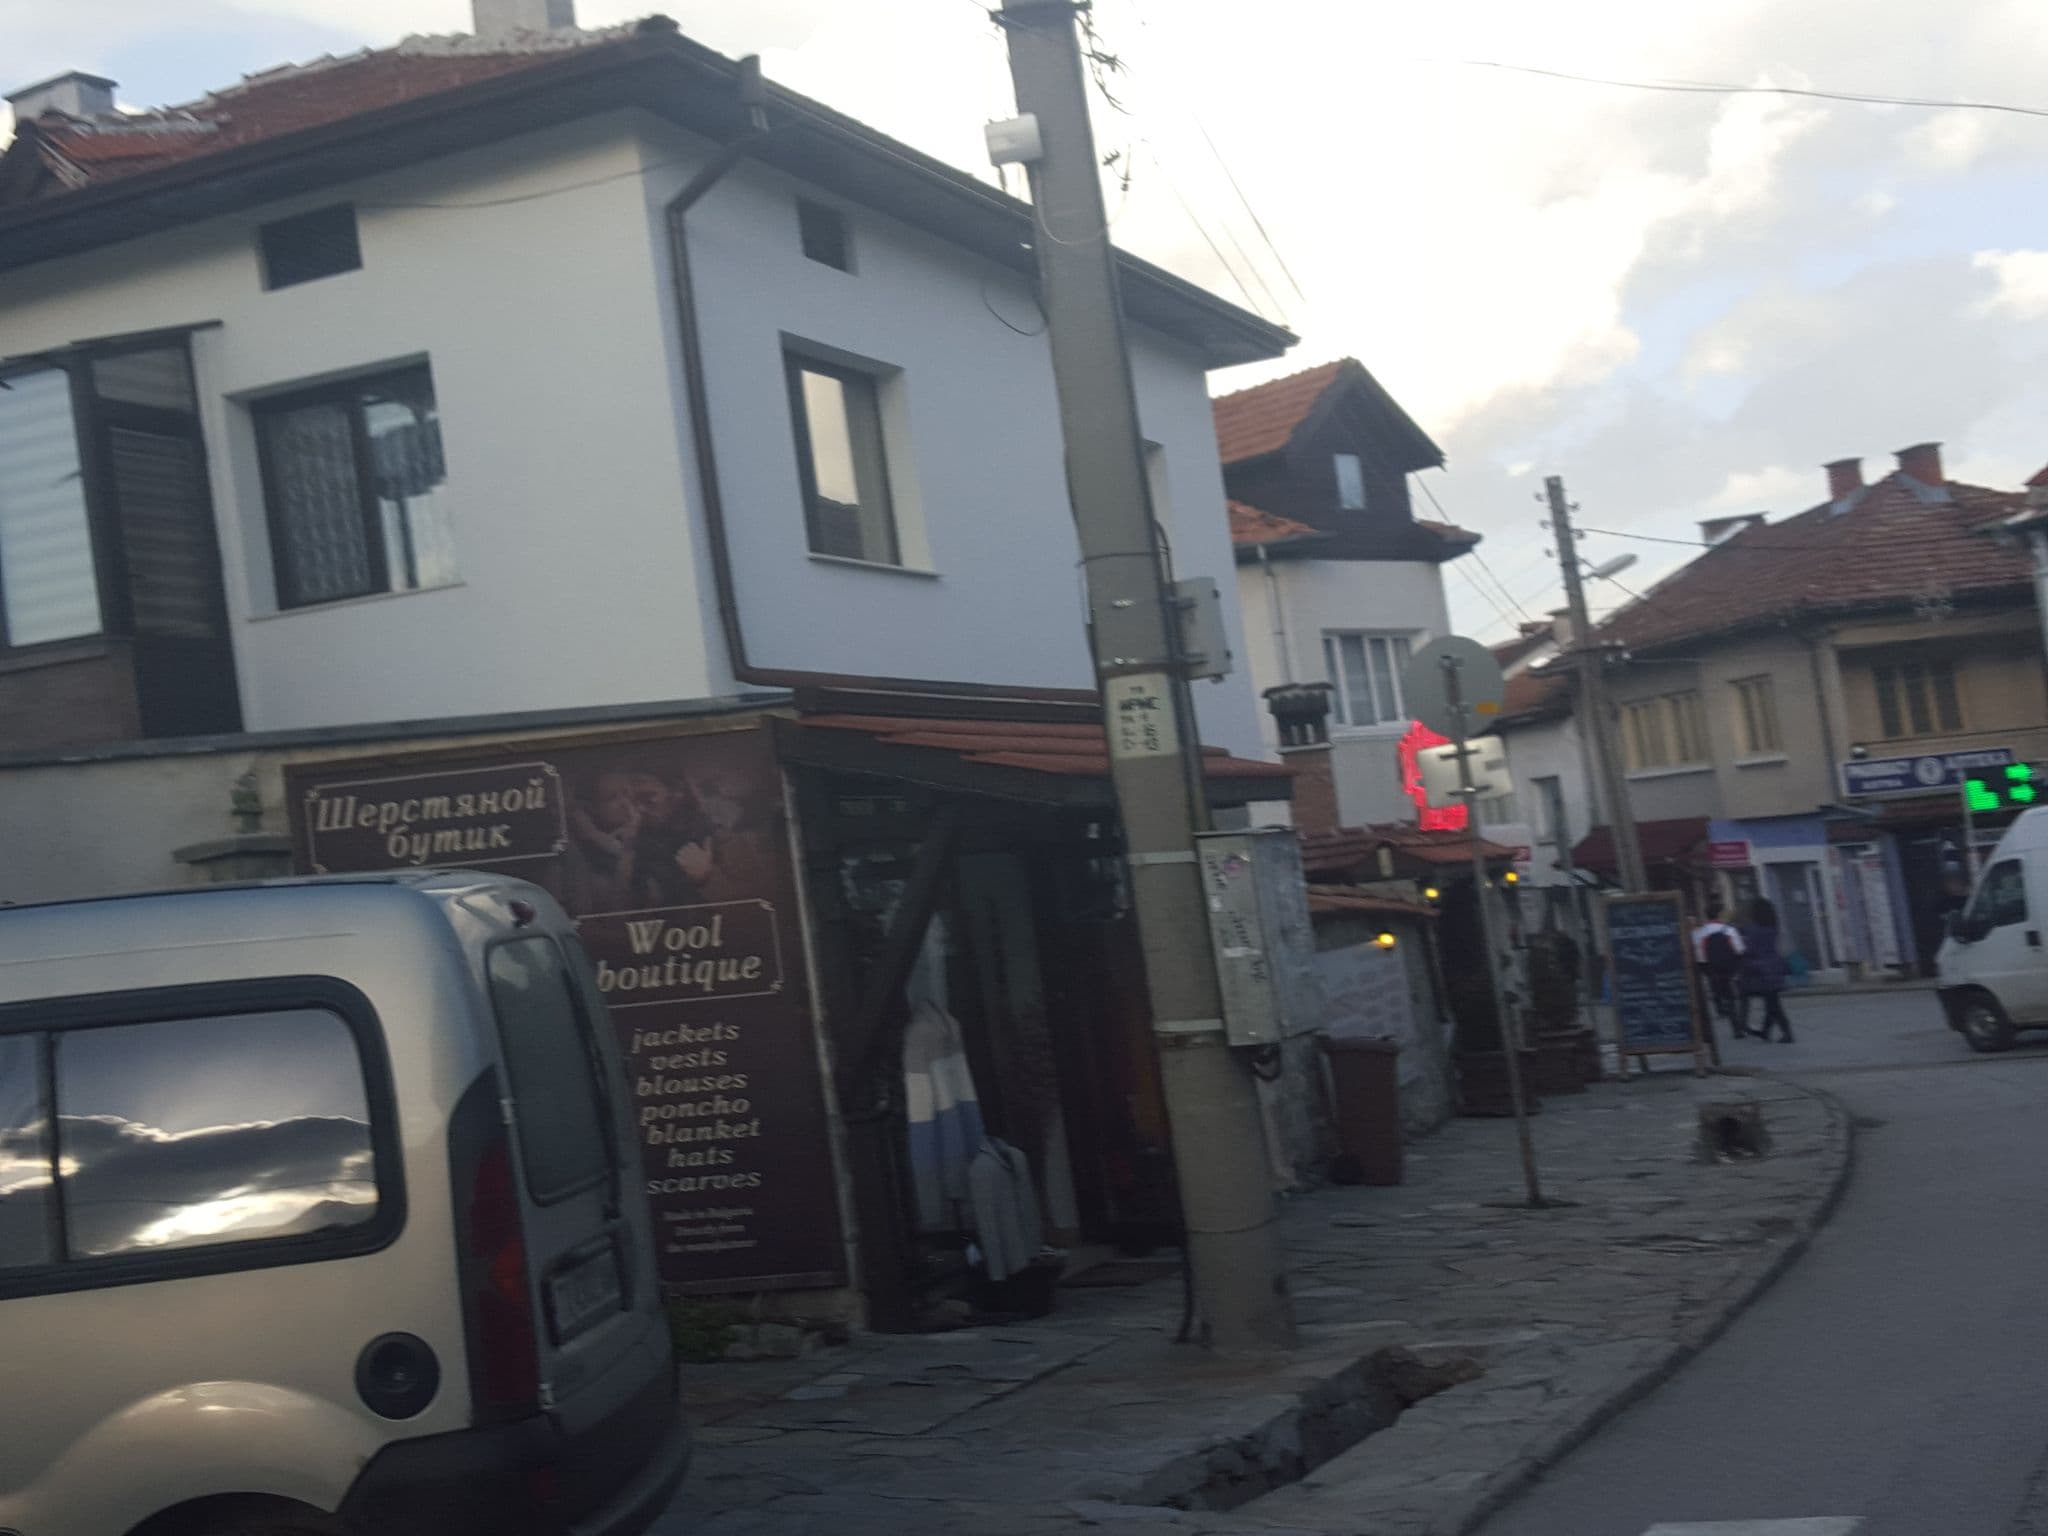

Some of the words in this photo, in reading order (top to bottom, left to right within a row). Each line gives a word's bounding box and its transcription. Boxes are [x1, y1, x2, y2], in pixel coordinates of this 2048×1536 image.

[314, 777, 548, 835] Шерстяной
[387, 822, 512, 865] бутик
[625, 914, 724, 955] Wool
[597, 953, 764, 996] boutique
[631, 1021, 740, 1054] jackets
[636, 1072, 749, 1097] blouses
[640, 1094, 751, 1126] poncho
[646, 1117, 761, 1145] blanket
[667, 1146, 734, 1168] hats
